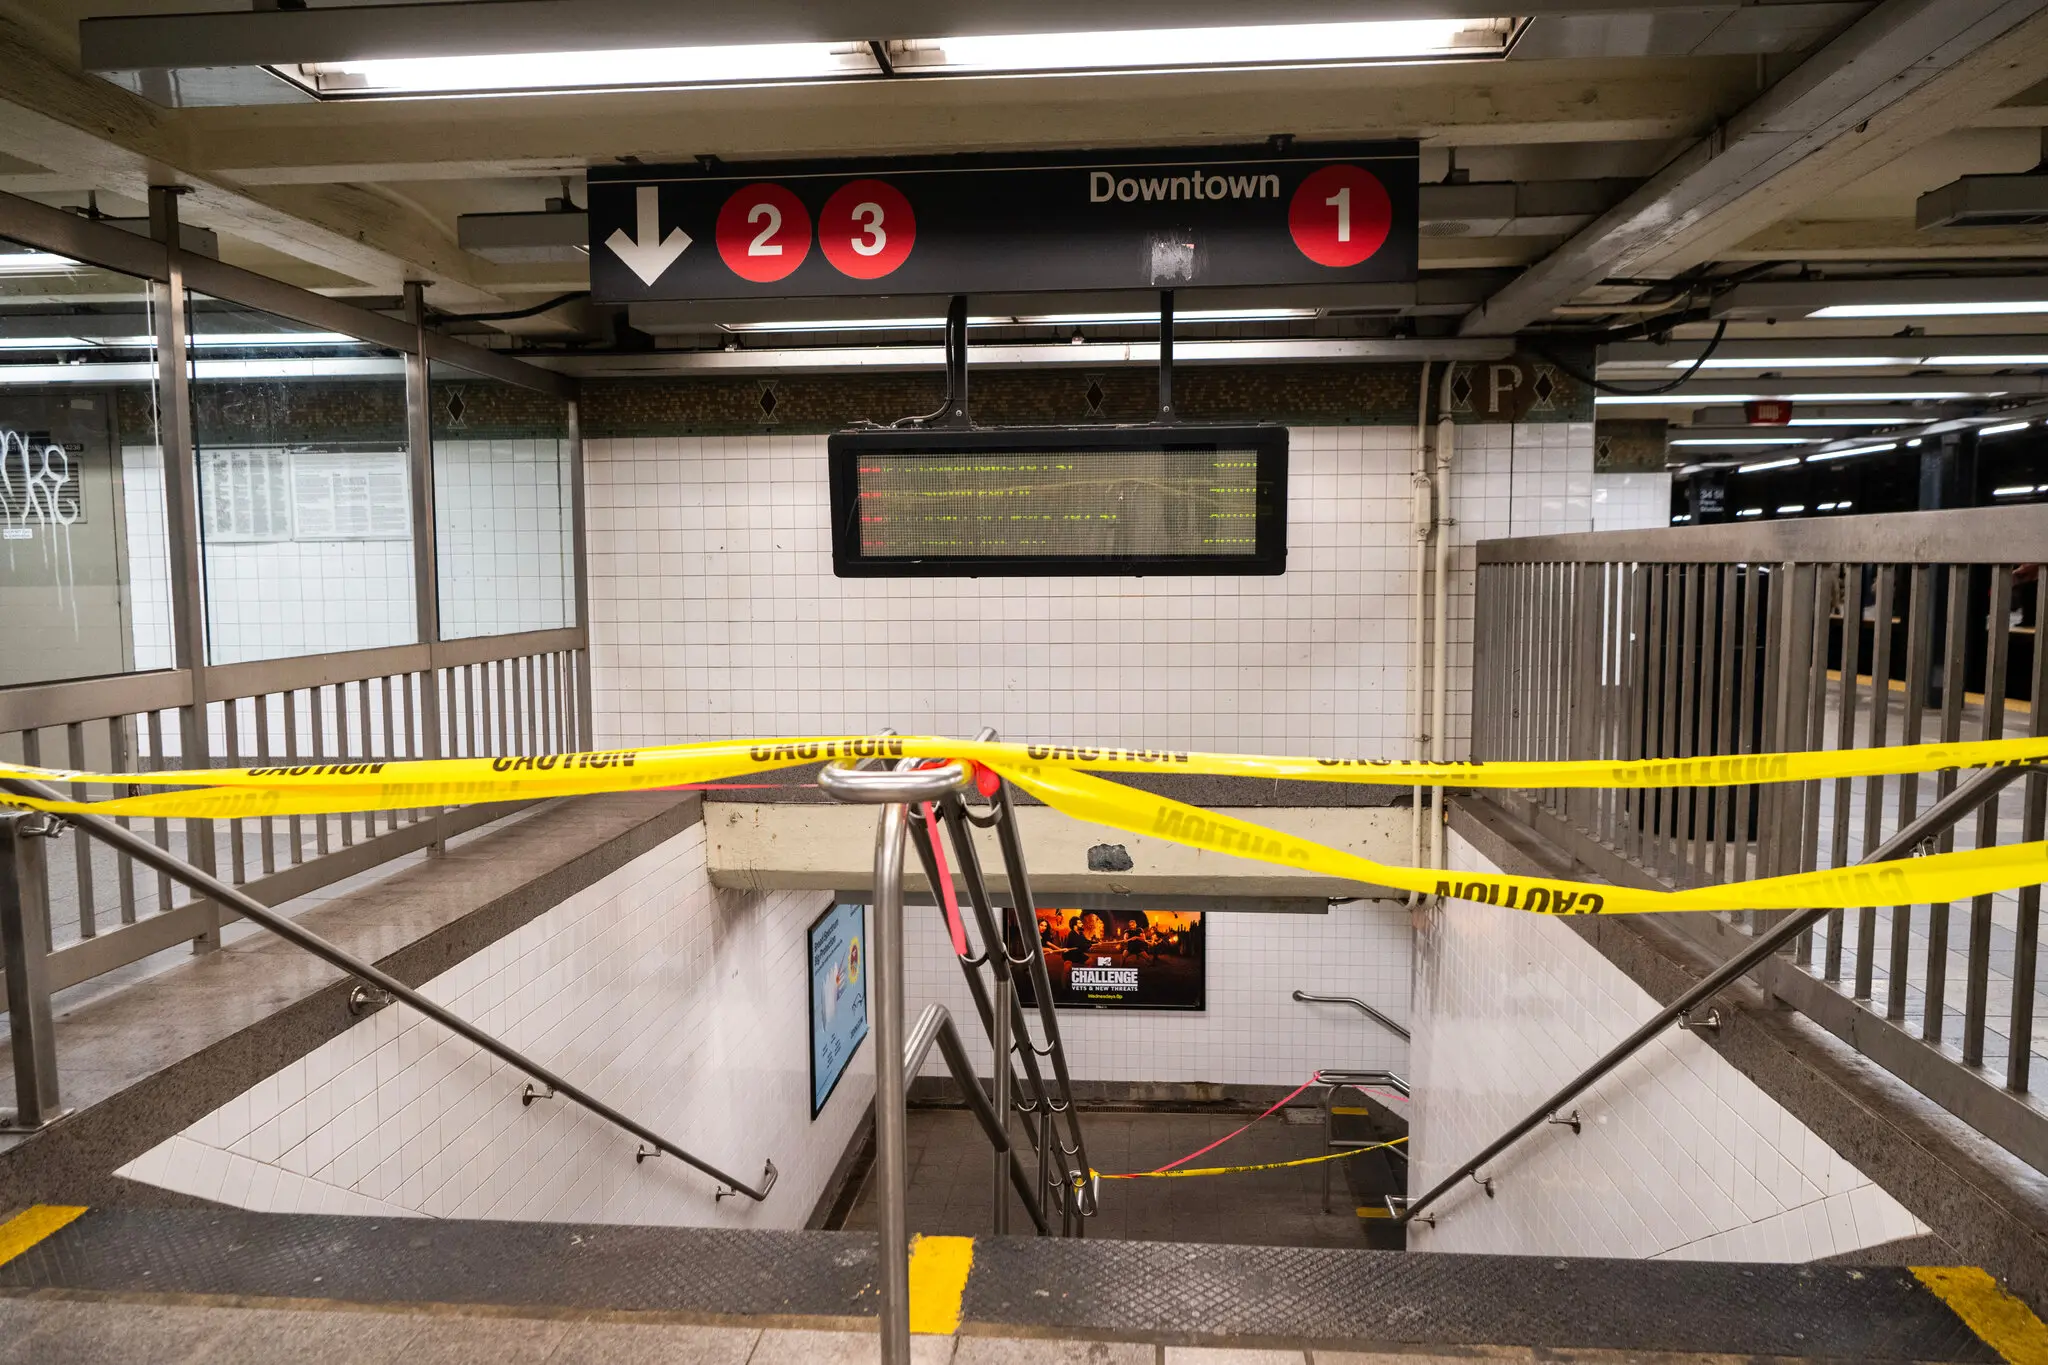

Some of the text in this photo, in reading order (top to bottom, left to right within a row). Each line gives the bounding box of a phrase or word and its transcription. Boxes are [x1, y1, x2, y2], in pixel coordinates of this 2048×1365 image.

[1089, 170, 1280, 203] Downtown
[747, 202, 887, 256] 2 3
[1326, 187, 1350, 242] 1
[1488, 364, 1523, 412] P
[492, 751, 636, 772] CAUTION
[1435, 881, 1605, 914] CAUTION
[1072, 971, 1138, 983] CHALLENGE
